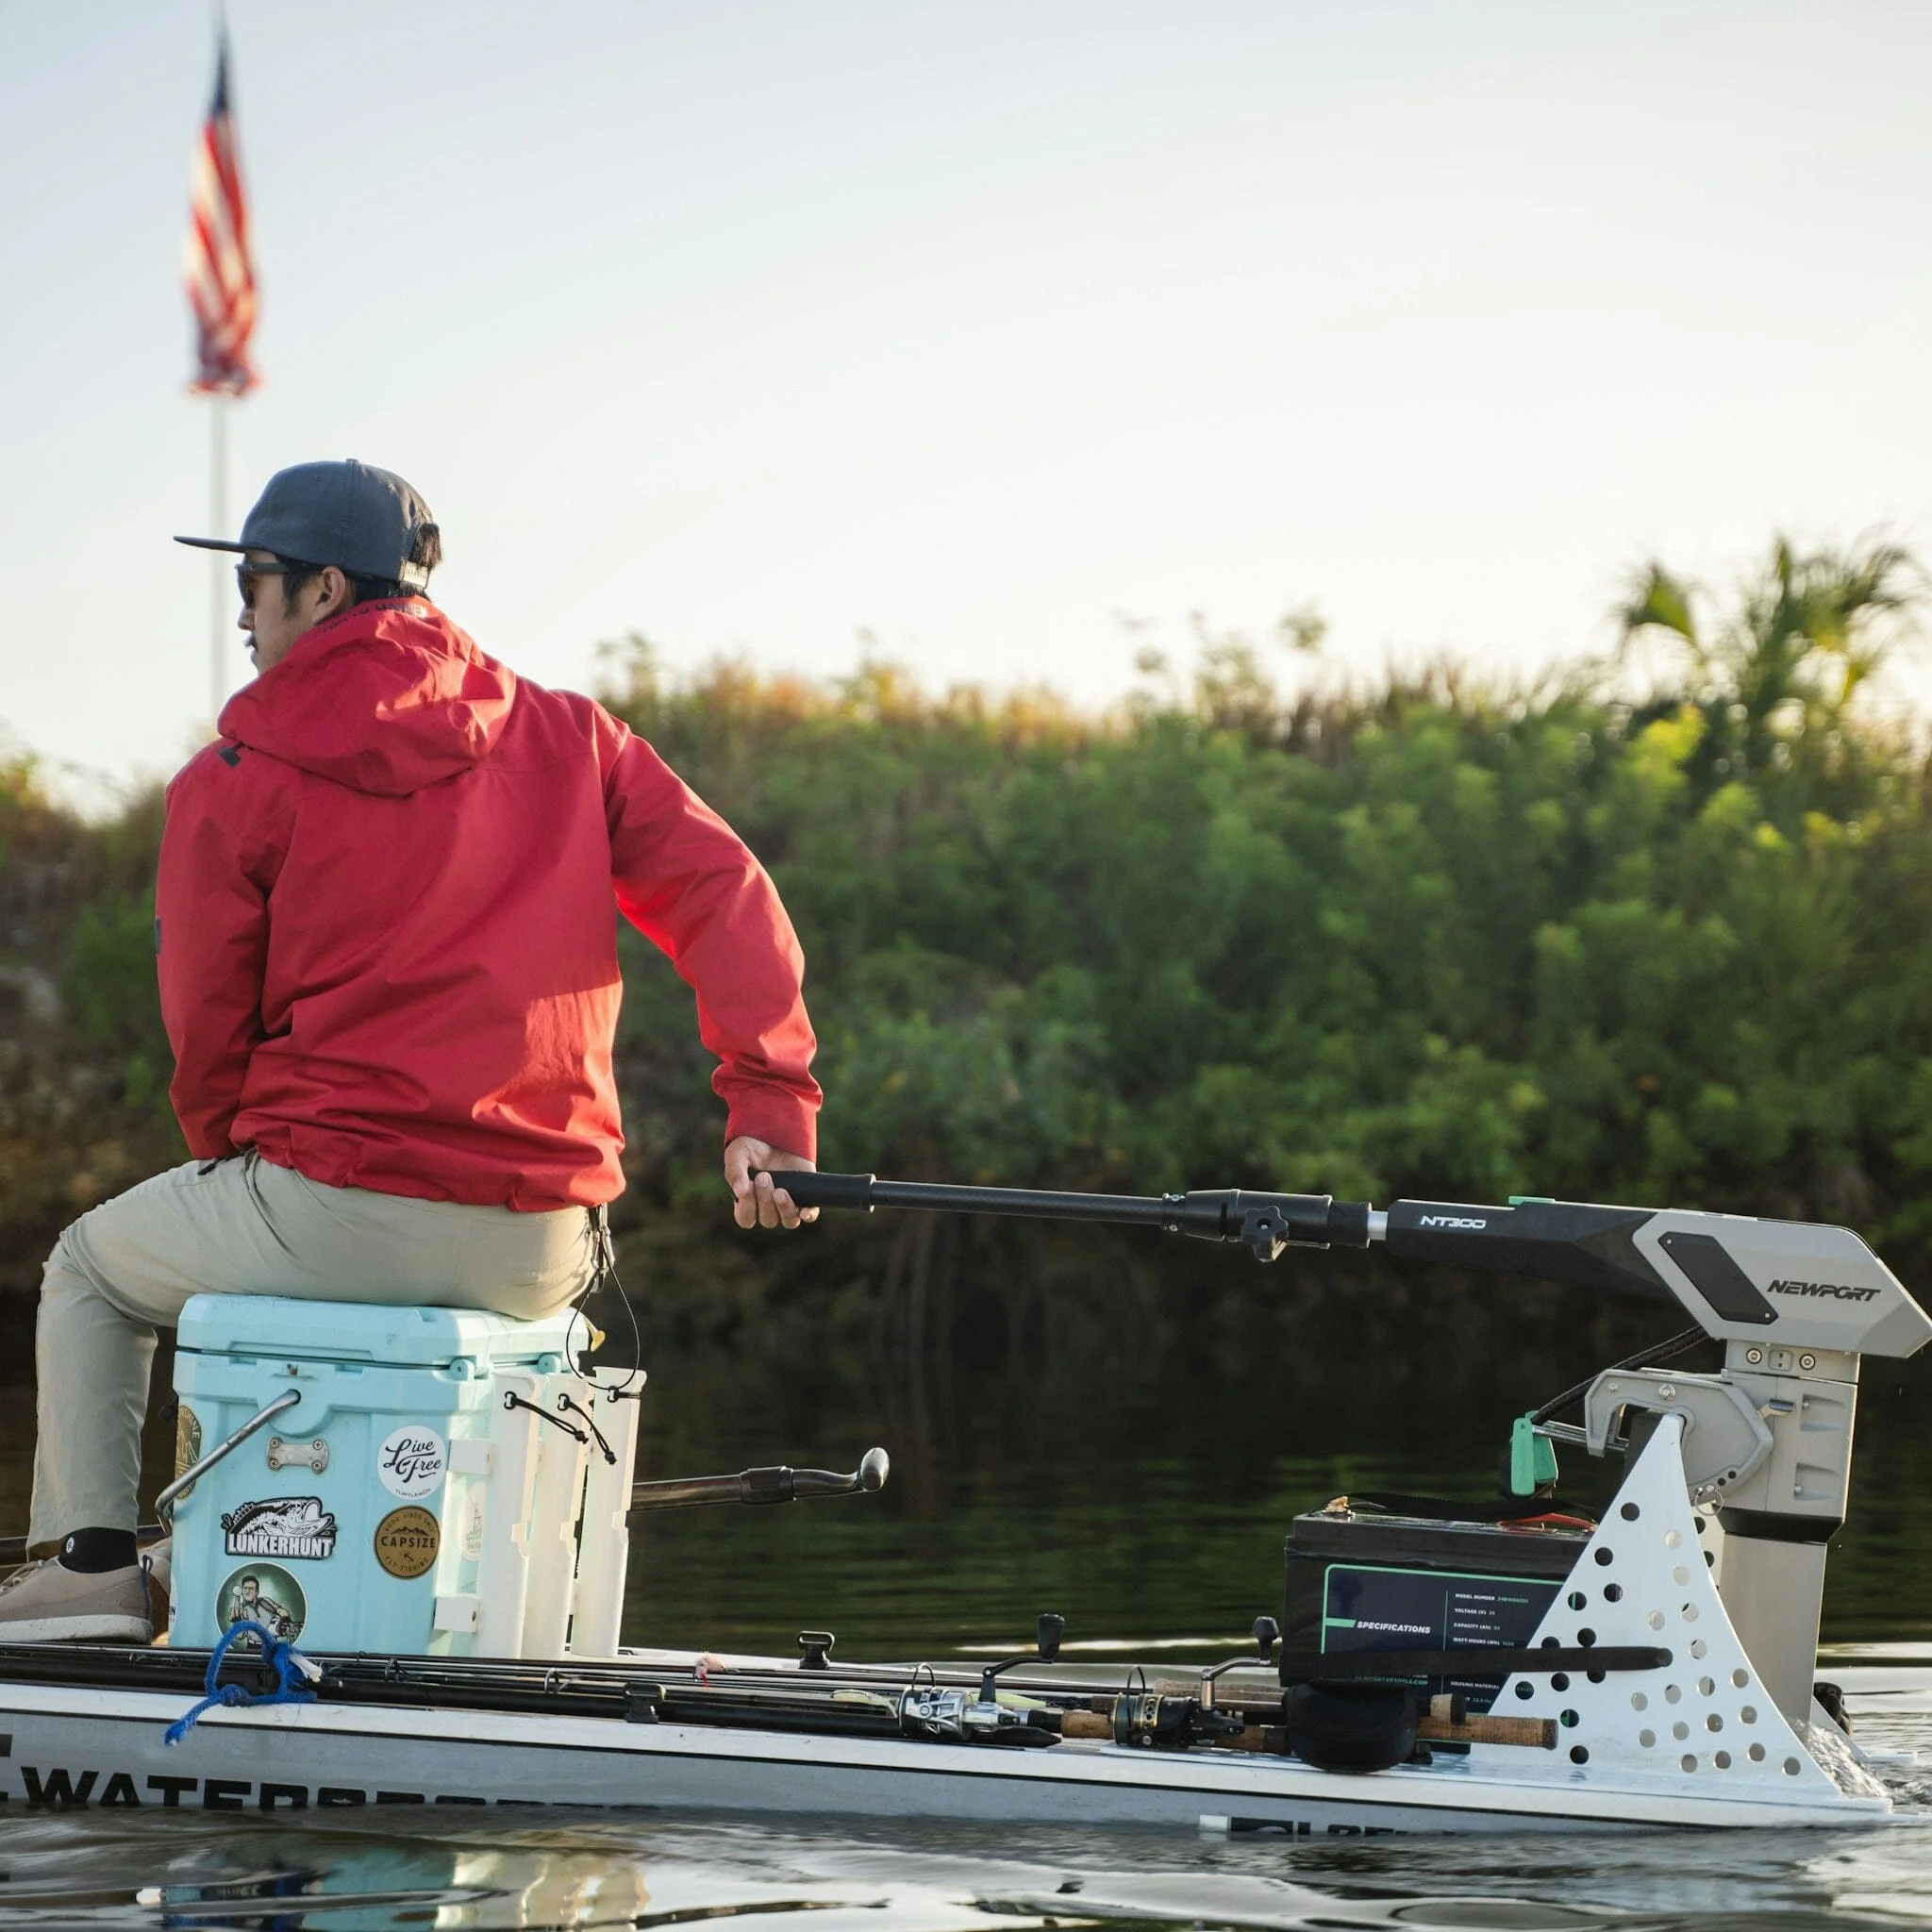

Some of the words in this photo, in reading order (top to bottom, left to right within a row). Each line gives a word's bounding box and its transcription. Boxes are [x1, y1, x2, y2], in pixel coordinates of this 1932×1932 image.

[1421, 1215, 1488, 1229] NT300
[1767, 1279, 1881, 1302] NEWPORT
[384, 1439, 436, 1469] Live
[395, 1451, 442, 1484] Free
[228, 1532, 332, 1557] LUNKERHUNT
[380, 1536, 436, 1548] CAPSIZE
[400, 1557, 429, 1574] FISHING
[1357, 1621, 1431, 1634] SPECIFICATIONS
[1454, 1622, 1478, 1630] CAPACITY
